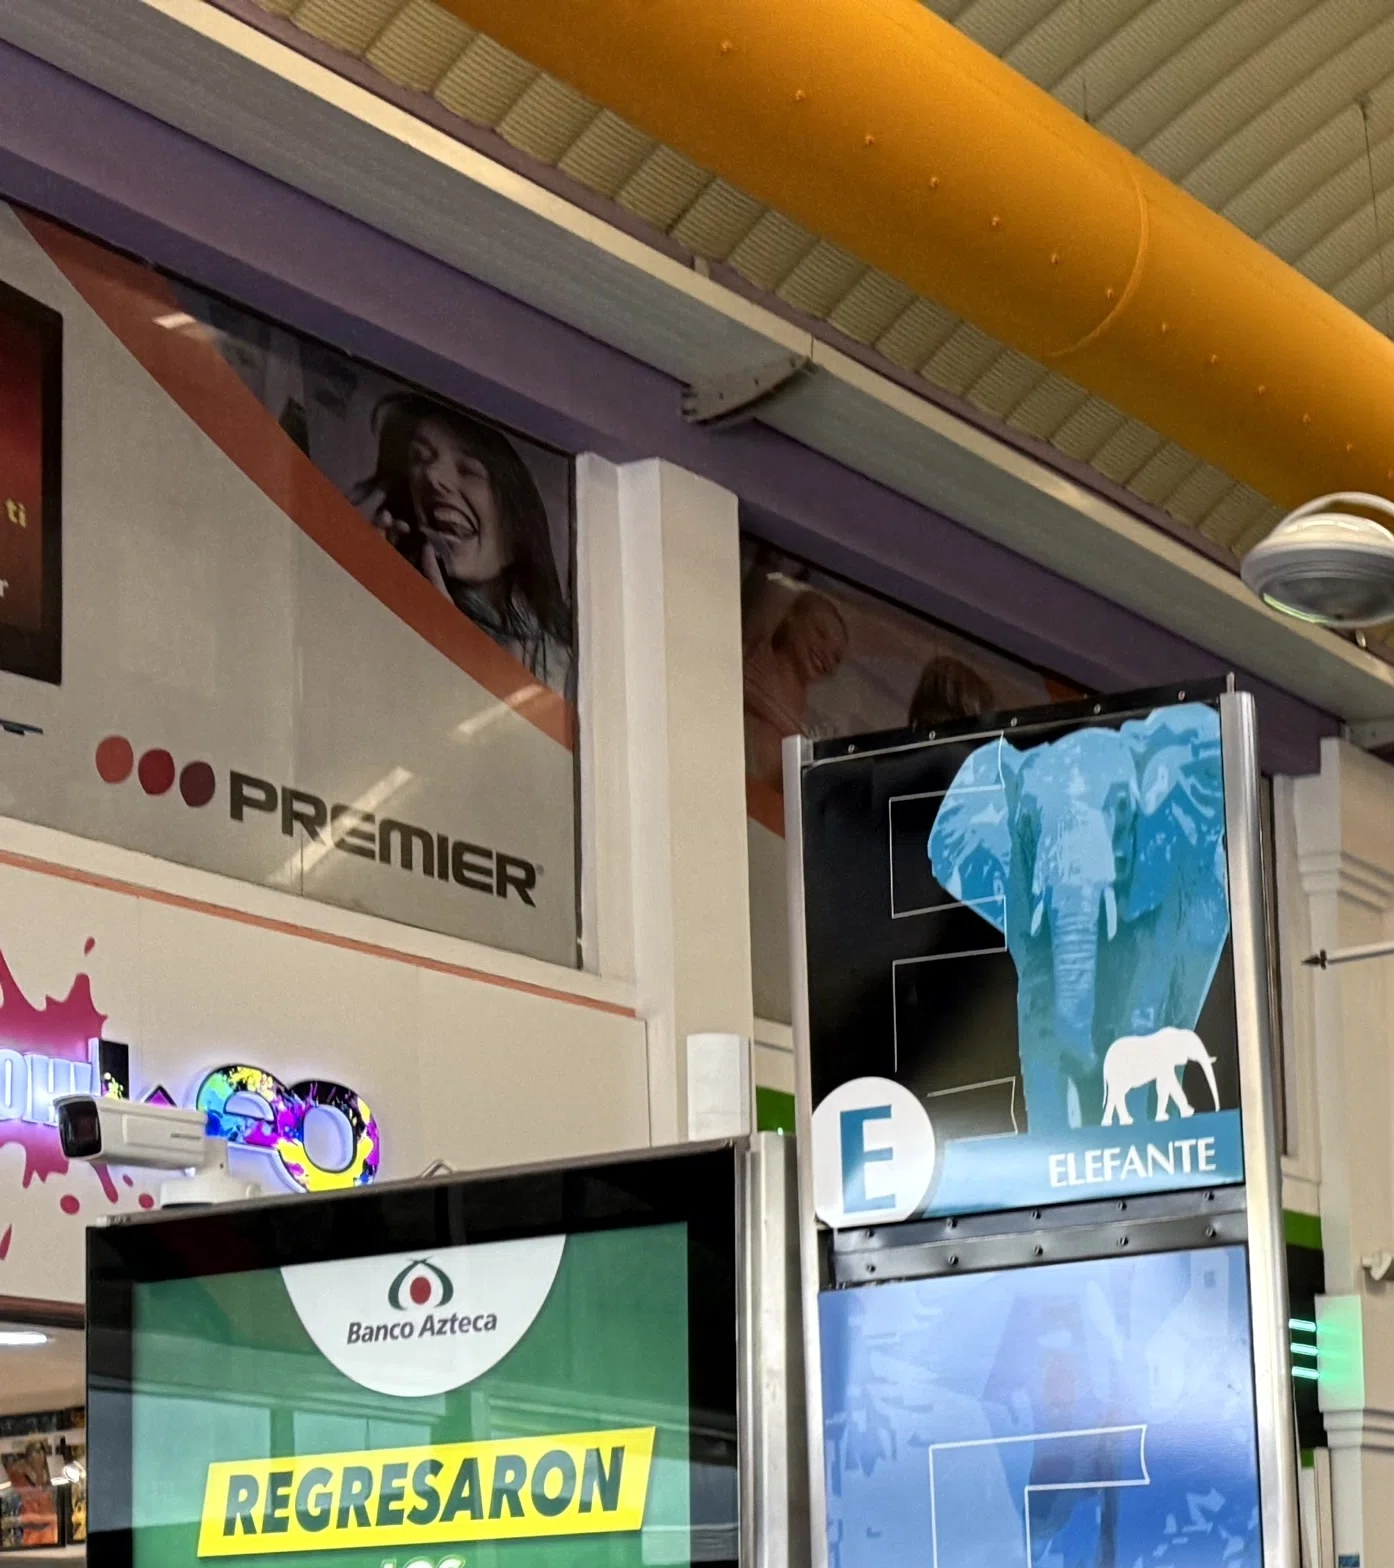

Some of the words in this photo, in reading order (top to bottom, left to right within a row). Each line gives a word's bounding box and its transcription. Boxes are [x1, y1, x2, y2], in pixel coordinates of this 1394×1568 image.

[229, 769, 537, 909] PREMIER
[839, 1103, 897, 1214] E
[1047, 1136, 1217, 1188] ELEFANTE
[346, 1321, 415, 1345] Banco
[418, 1312, 498, 1338] Azteca
[222, 1446, 625, 1537] REGRESARON
